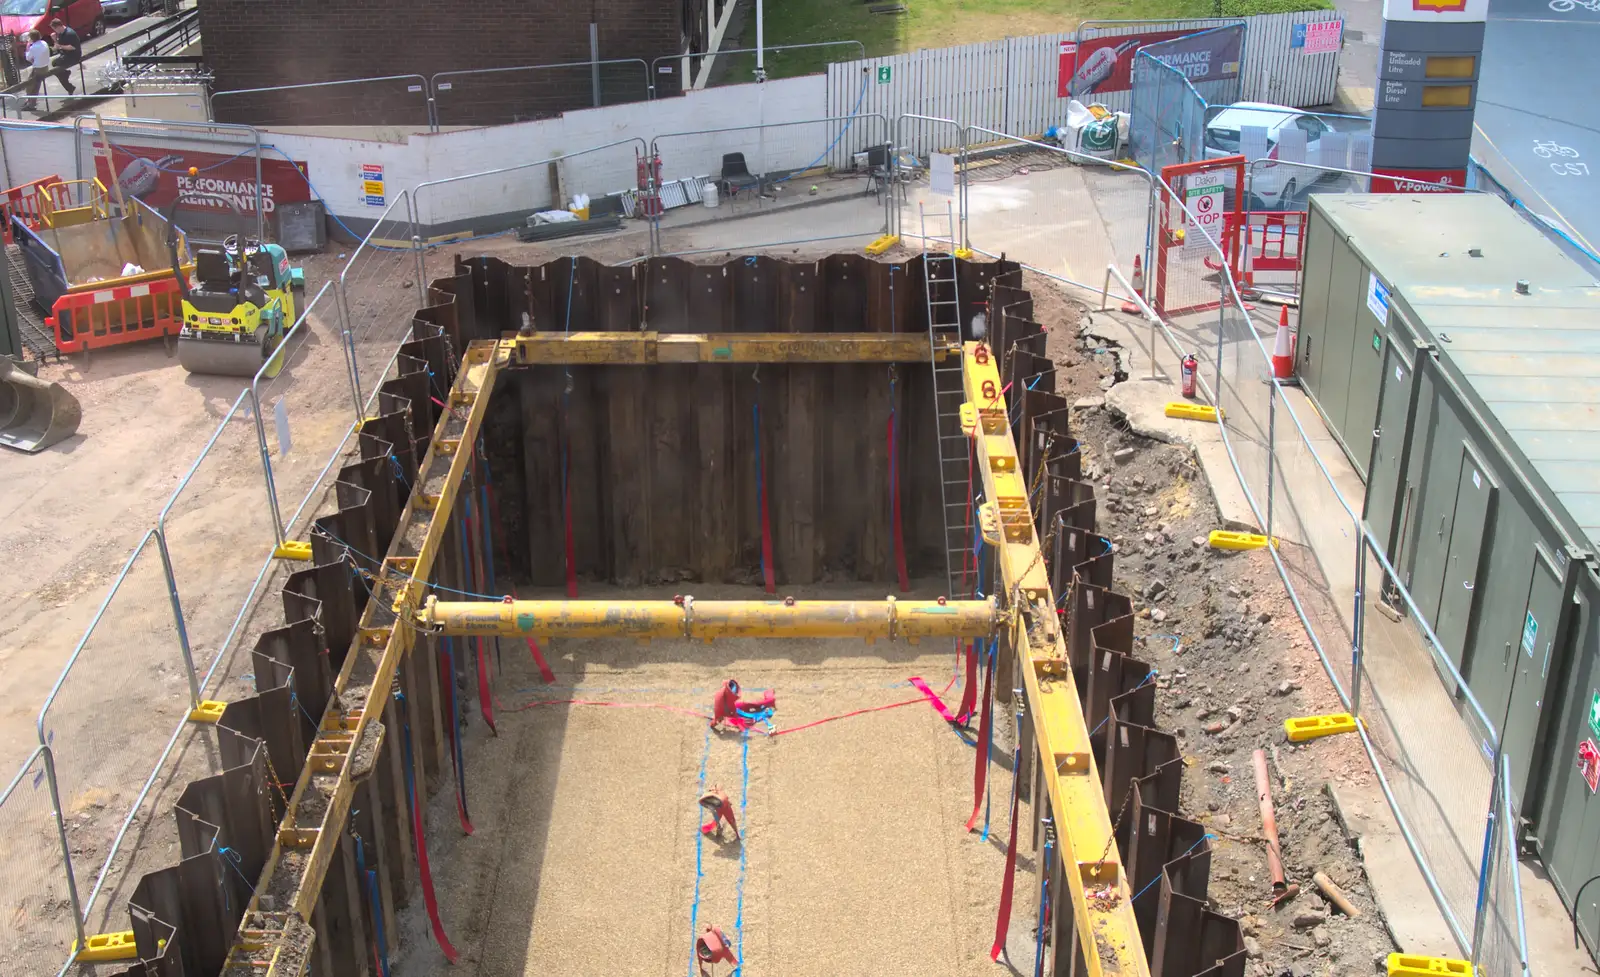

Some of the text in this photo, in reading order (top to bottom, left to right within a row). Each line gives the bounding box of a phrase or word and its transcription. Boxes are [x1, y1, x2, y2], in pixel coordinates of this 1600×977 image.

[1389, 57, 1421, 66] Unleaded
[1388, 65, 1404, 73] Litre
[1386, 87, 1407, 95] Diesel
[1385, 95, 1400, 103] Litre
[1550, 162, 1590, 175] CS7
[1393, 180, 1444, 192] V-Powe
[179, 188, 275, 213] REINVNTD
[1189, 213, 1220, 227] STOP
